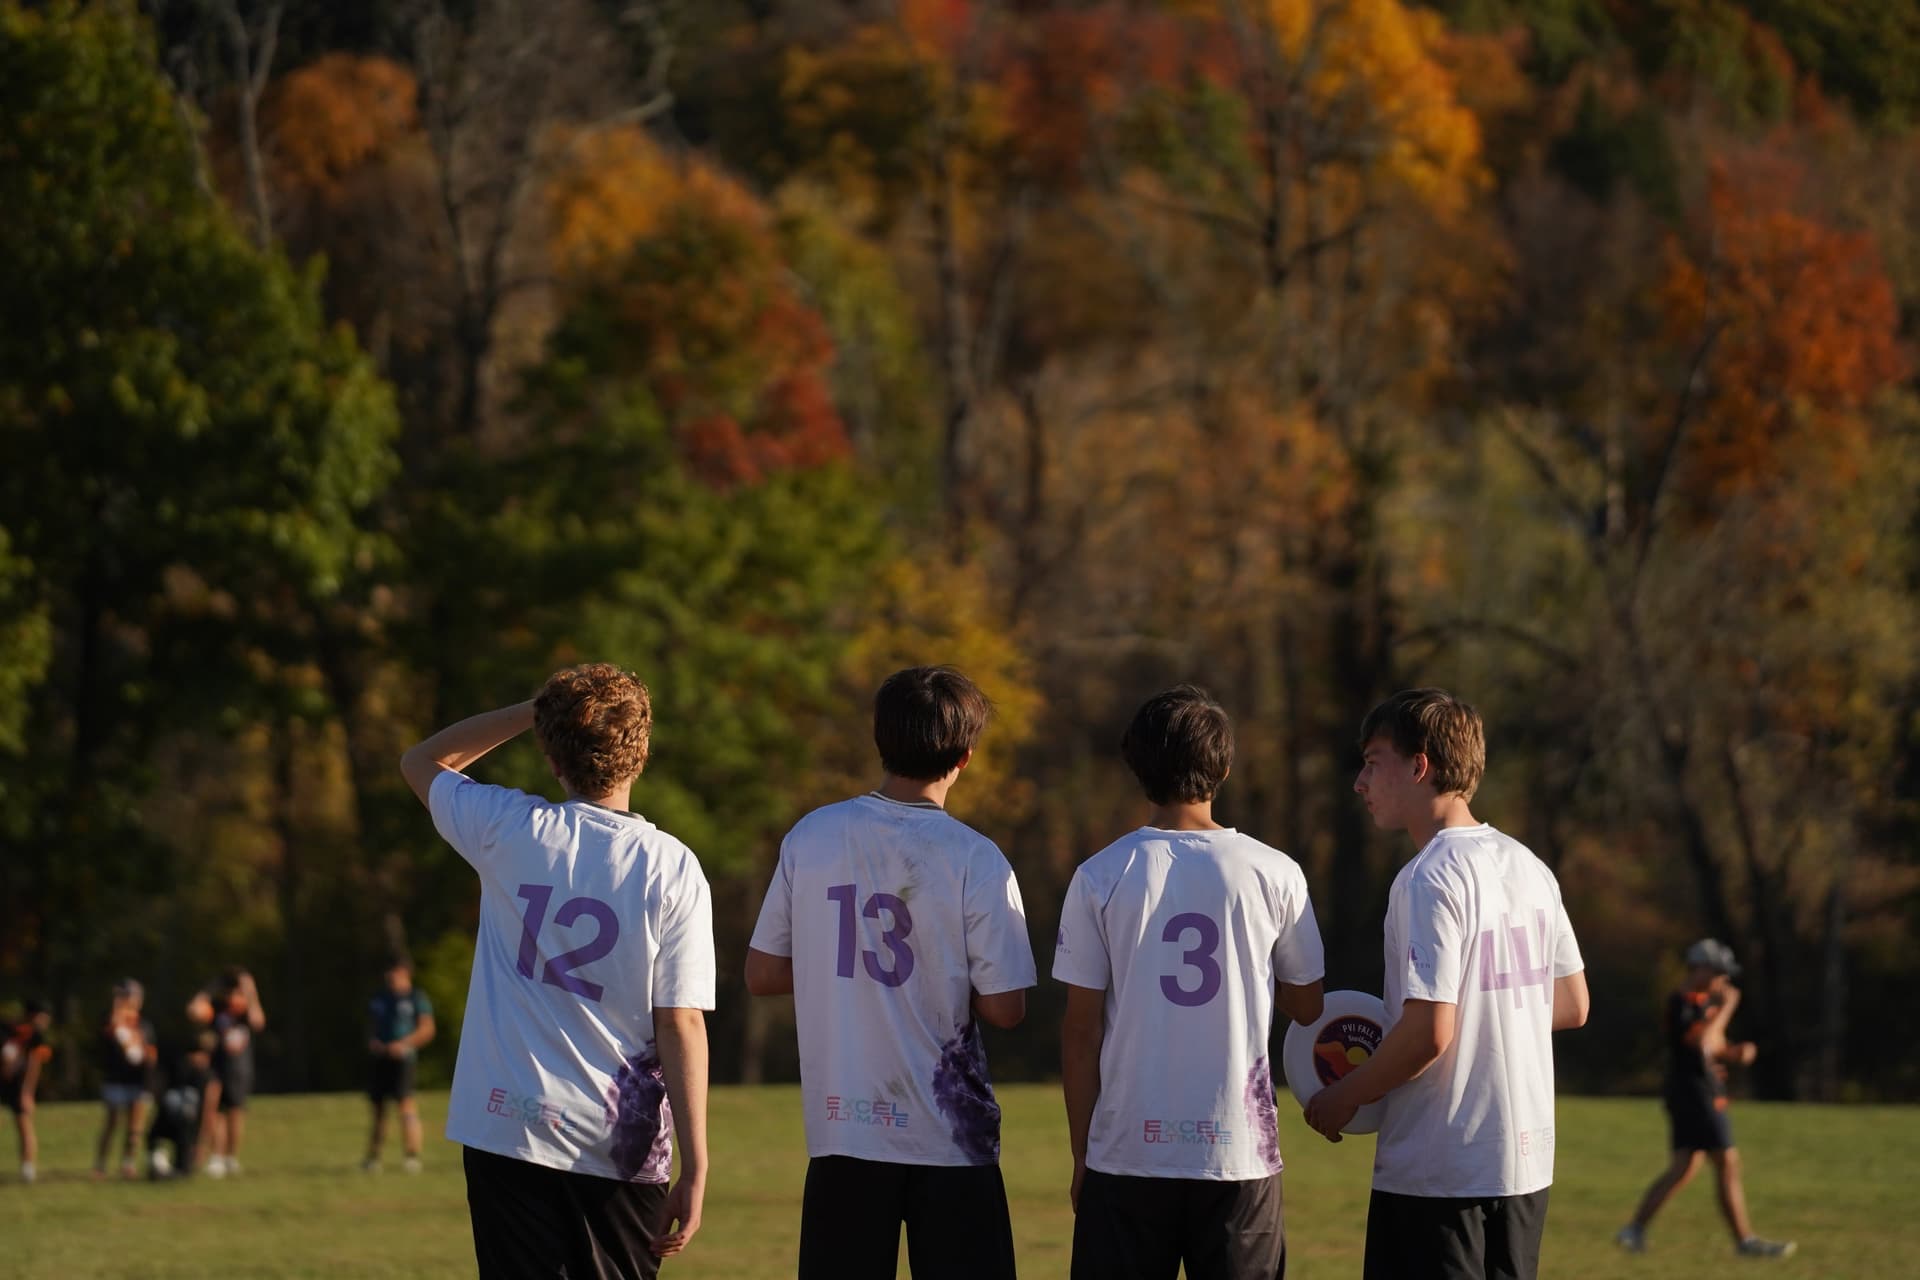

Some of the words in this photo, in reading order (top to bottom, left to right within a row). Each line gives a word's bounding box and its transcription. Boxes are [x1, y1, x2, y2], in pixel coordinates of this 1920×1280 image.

[516, 883, 620, 1003] 12
[827, 883, 915, 988] 13
[1159, 912, 1222, 1008] 3
[1342, 1023, 1356, 1033] PVI
[826, 1096, 909, 1117] EXCEL
[1143, 1119, 1233, 1134] EXCEL
[1143, 1133, 1233, 1145] ULTIMATE
